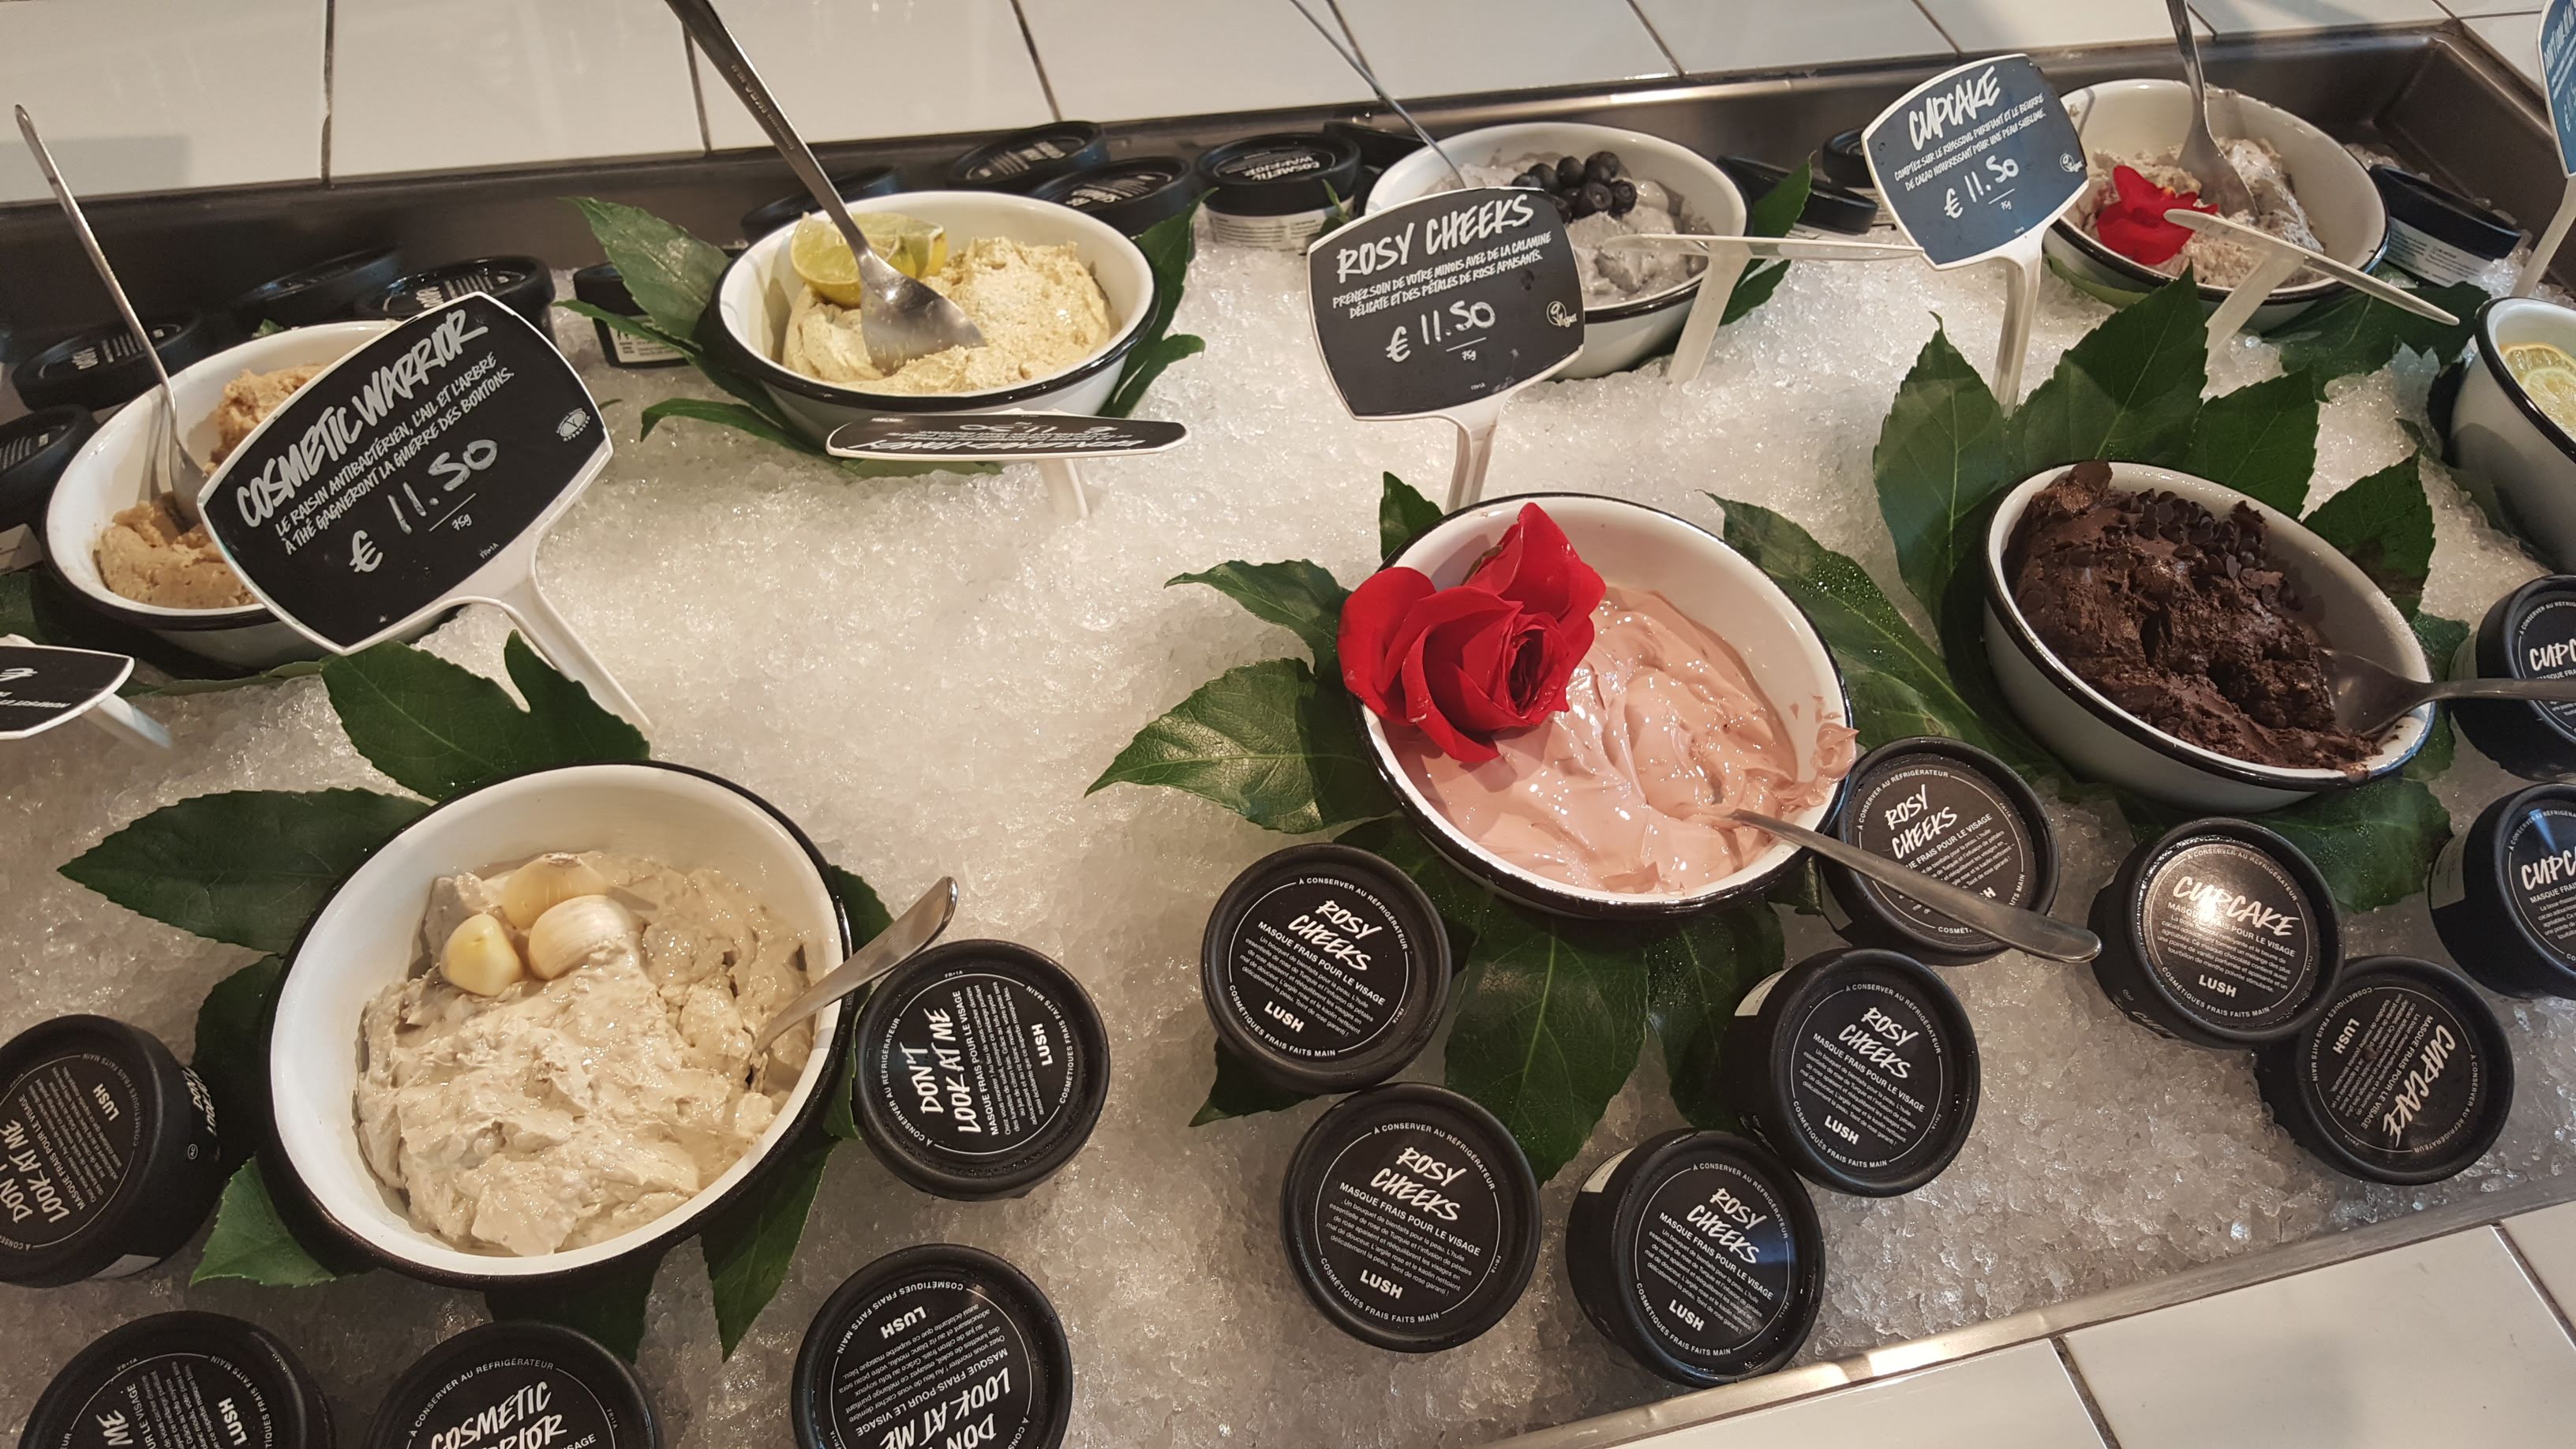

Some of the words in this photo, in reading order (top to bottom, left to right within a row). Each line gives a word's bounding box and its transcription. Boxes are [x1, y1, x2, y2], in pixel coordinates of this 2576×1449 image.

[1908, 66, 2000, 151] CUPCAKE
[1945, 189, 1964, 218] €
[1964, 155, 2019, 202] 11.50
[1337, 222, 1414, 283] ROSY
[1425, 194, 1533, 255] CHEEKS
[1333, 289, 1372, 309] PRENEZ
[1370, 281, 1391, 297] SOIN
[1390, 276, 1405, 290] DE
[1406, 268, 1433, 285] VOTRE
[1432, 259, 1466, 278] MINOIS
[1466, 253, 1486, 268] AVEC
[1487, 247, 1500, 261] DE
[1500, 245, 1511, 257] LA
[1512, 231, 1551, 254] CALAMINE
[1350, 296, 1389, 319] DÉLICATE
[1387, 290, 1405, 306] ET
[1401, 287, 1421, 302] DES
[1421, 275, 1458, 296] PÉTALES
[1456, 270, 1473, 285] DE
[1470, 263, 1498, 281] ROSE
[1494, 249, 1542, 274] APAISANTS.
[1386, 327, 1410, 362] €
[1421, 301, 1496, 345] 11.50
[1462, 350, 1476, 361] 75g
[237, 406, 364, 527] COSMETIC
[353, 309, 489, 418] WARRIOR
[275, 516, 290, 537] LE
[290, 486, 328, 526] RAISIN
[329, 421, 414, 495] ANTIBACTÉRIEN,
[412, 402, 438, 427] L'AIL
[436, 385, 456, 407] ET
[447, 352, 496, 396] L'ARBRE
[292, 518, 316, 546] THÉ
[316, 467, 384, 530] GAGNERONT
[376, 461, 395, 479] LA
[394, 422, 439, 467] GUERRE
[437, 406, 462, 431] DES
[460, 368, 515, 413] BOUTONS.
[350, 530, 383, 573] €
[388, 440, 498, 535] 11.50
[452, 514, 472, 531] 75g
[2529, 638, 2576, 671] CUPC
[1885, 784, 1928, 830] ROSY
[1892, 806, 1957, 859] CHEEKS
[1916, 848, 1938, 863] FRAIS
[1937, 836, 1957, 851] POUR
[1956, 829, 1968, 838] LE
[1966, 814, 1992, 832] VISAGE
[2522, 850, 2576, 890] CUPC
[2173, 876, 2300, 937] CUPCAKE
[2530, 889, 2559, 903] MASQUE
[1316, 900, 1382, 940] ROSY
[2229, 923, 2254, 939] POUR
[2256, 935, 2266, 944] LE
[2267, 940, 2295, 957] VISAGE
[1288, 915, 1372, 971] CHEEKS
[1258, 922, 1294, 947] MASQUE
[1294, 944, 1318, 962] FRAIS
[1318, 959, 1342, 978] POUR
[1343, 975, 1354, 986] LE
[1356, 982, 1385, 1005] VISAGE
[2199, 975, 2237, 998] LUSH
[923, 1007, 956, 1041] ME
[953, 991, 968, 1023] VISAGE
[1264, 1001, 1305, 1032] LUSH
[1861, 1007, 1919, 1047] ROSY
[963, 1024, 972, 1035] LE
[1032, 1024, 1052, 1065] LUSH
[2333, 1018, 2359, 1054] LUSH
[2412, 1015, 2433, 1047] MASQUE
[931, 1043, 965, 1072] AT
[966, 1037, 979, 1063] POUR
[1838, 1024, 1911, 1079] CHEEKS
[2399, 1046, 2415, 1069] FRAIS
[900, 1042, 944, 1114] DON'T
[974, 1065, 987, 1092] FRAIS
[1814, 1033, 1844, 1058] MASQUE
[1844, 1054, 1866, 1073] FRAIS
[1866, 1069, 1887, 1088] POUR
[1888, 1084, 1898, 1094] LE
[1899, 1091, 1925, 1112] VISAGE
[2383, 1024, 2456, 1148] CUPCAKE
[2385, 1069, 2402, 1091] POUR
[93, 1084, 120, 1121] LUSH
[945, 1073, 982, 1133] LOOK
[982, 1094, 999, 1135] MASQUE
[2361, 1102, 2382, 1129] VISAGE
[2378, 1091, 2388, 1102] LE
[0, 1120, 28, 1150] ME
[1824, 1115, 1859, 1144] LUSH
[9, 1149, 41, 1174] AT
[1396, 1147, 1466, 1186] ROSY
[28, 1170, 69, 1222] LOOK
[1371, 1168, 1461, 1220] CHEEKS
[1709, 1188, 1767, 1230] ROSY
[1340, 1182, 1379, 1206] MASQUE
[1380, 1201, 1406, 1219] FRAIS
[1408, 1215, 1433, 1233] POUR
[1435, 1228, 1447, 1239] LE
[1449, 1234, 1481, 1256] VISAGE
[1687, 1204, 1759, 1264] CHEEKS
[1660, 1212, 1693, 1240] MASQUE
[1693, 1237, 1715, 1256] FRAIS
[1715, 1253, 1736, 1272] POUR
[1737, 1269, 1747, 1280] LE
[1748, 1276, 1773, 1300] VISAGE
[1320, 1257, 1364, 1308] COSMÉTIQUES
[1365, 1305, 1389, 1320] FRAIS
[1418, 1312, 1439, 1323] MAIN
[1360, 1269, 1402, 1299] LUSH
[880, 1306, 927, 1339] LUSH
[1668, 1299, 1704, 1331] LUSH
[937, 1372, 966, 1391] FRAIS
[968, 1350, 1008, 1375] MASQUE
[893, 1403, 906, 1416] LE
[908, 1387, 936, 1408] POUR
[947, 1368, 1010, 1420] LOOK
[219, 1398, 248, 1446] LUSH
[431, 1381, 551, 1449] COSMETIC
[856, 1412, 893, 1436] VISAGE
[880, 1419, 915, 1449] ME
[919, 1403, 948, 1446] AT
